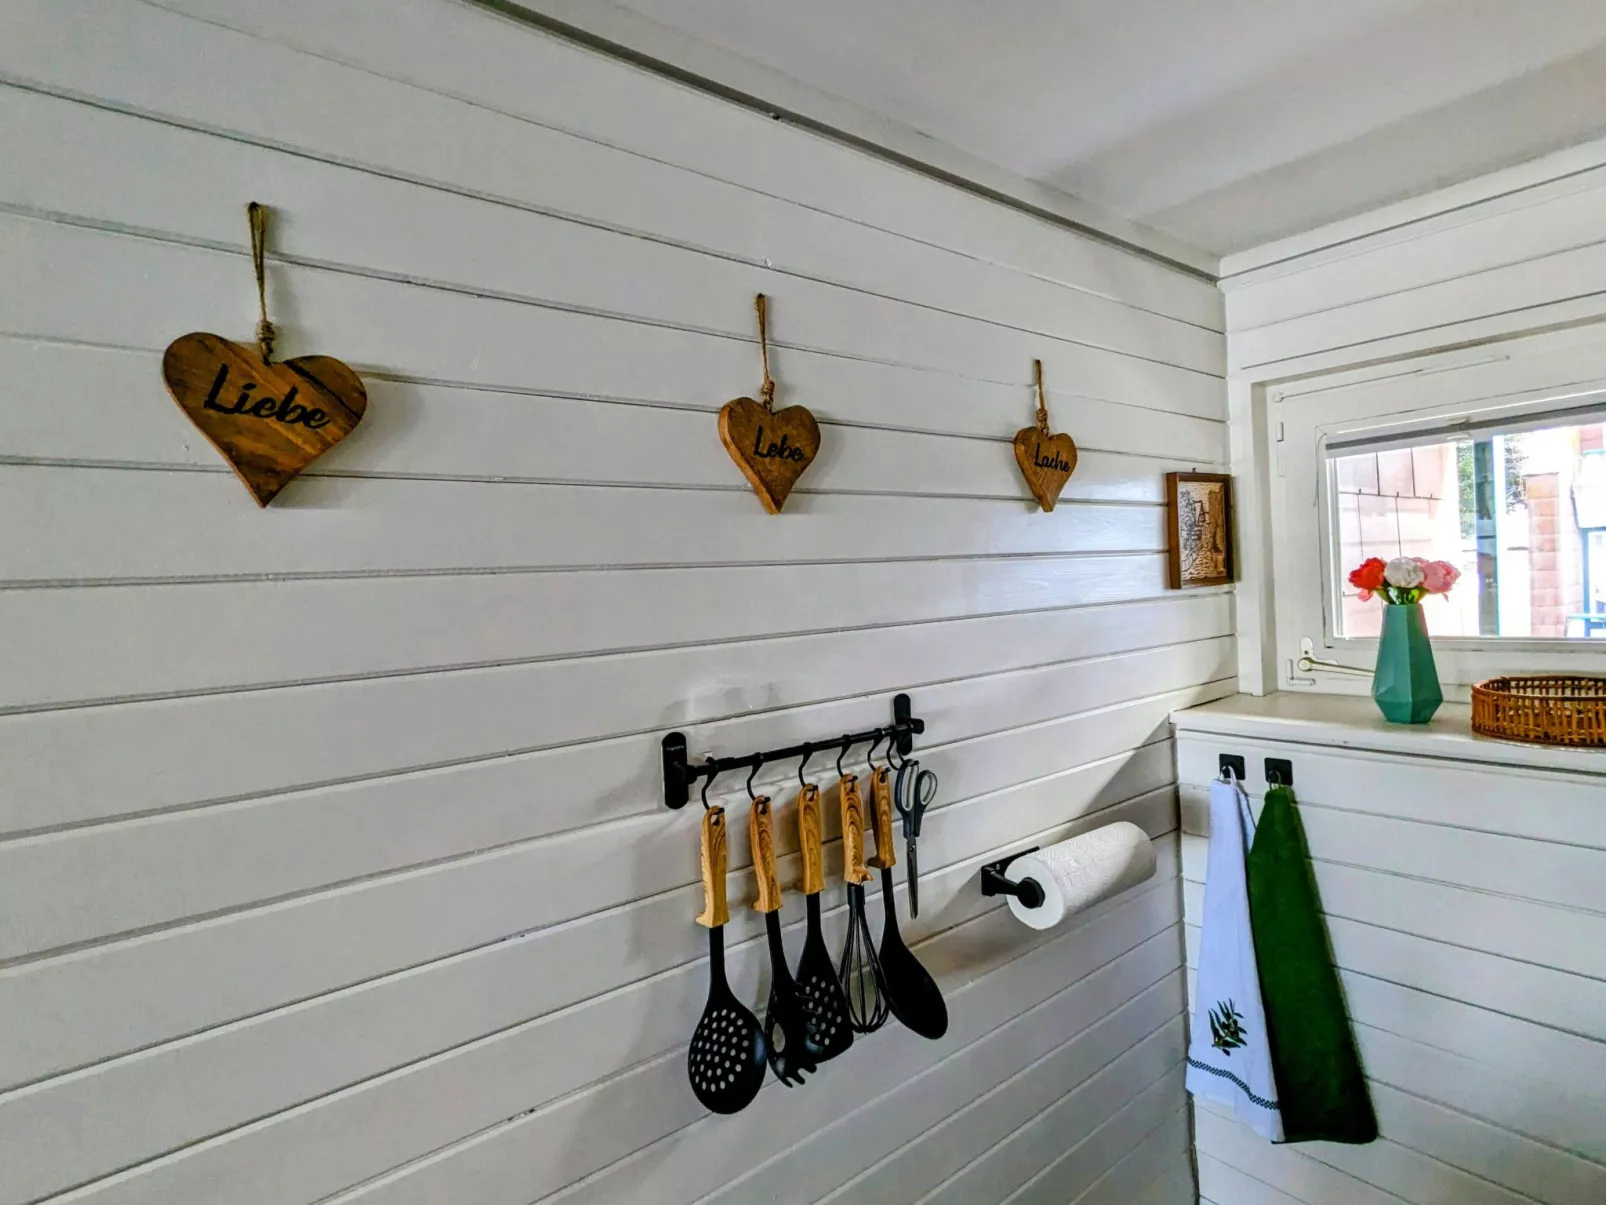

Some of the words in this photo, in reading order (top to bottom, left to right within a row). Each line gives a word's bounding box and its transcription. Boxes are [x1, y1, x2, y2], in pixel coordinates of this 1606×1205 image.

[203, 363, 331, 430] Liebe
[753, 424, 805, 463] Lebe
[1033, 442, 1071, 472] Lache
